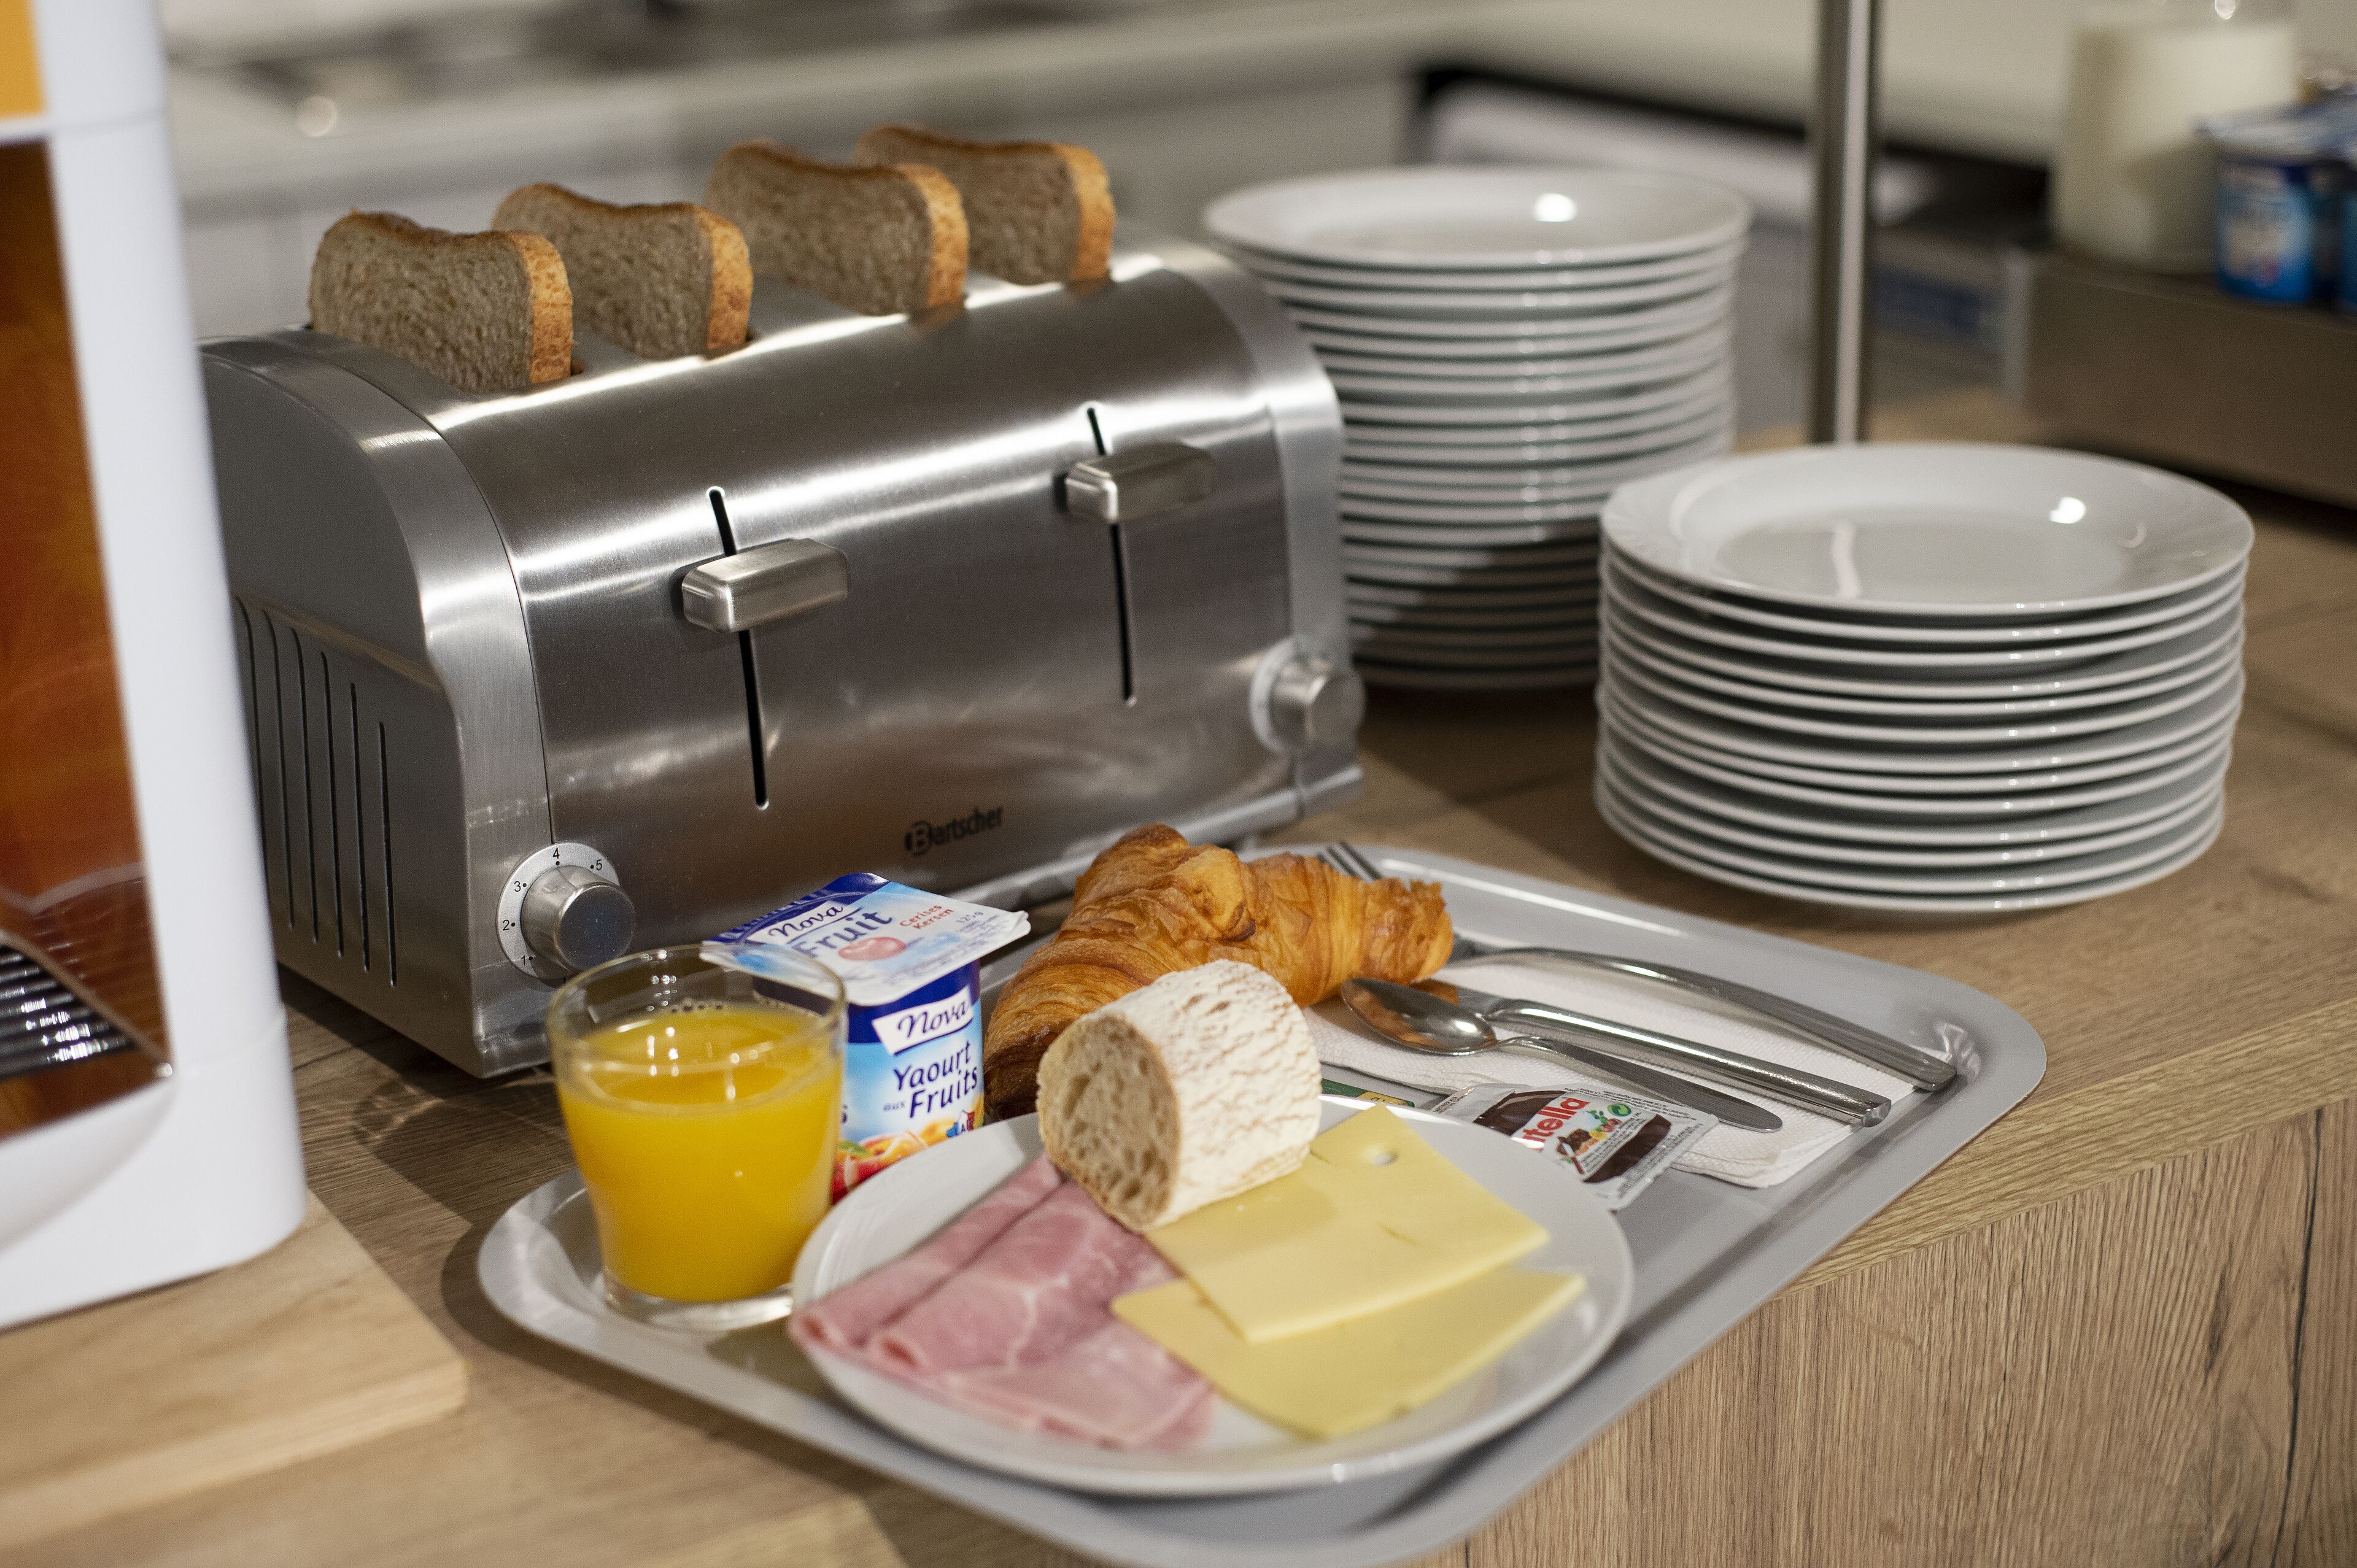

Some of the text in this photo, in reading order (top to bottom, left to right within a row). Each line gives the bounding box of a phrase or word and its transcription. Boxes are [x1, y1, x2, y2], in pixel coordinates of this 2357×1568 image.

[904, 806, 1003, 857] Bartscher
[552, 847, 560, 859] 4
[595, 859, 603, 871] 5
[514, 881, 522, 892] 3
[502, 919, 510, 931] 2
[768, 906, 843, 937] Nova
[900, 905, 942, 927] Cerises
[913, 908, 954, 930] Kersen
[791, 911, 893, 959] Fruit
[521, 955, 527, 966] 1
[897, 1000, 969, 1038] Nova
[893, 1041, 972, 1091] Yaourt
[909, 1066, 978, 1119] Fruits
